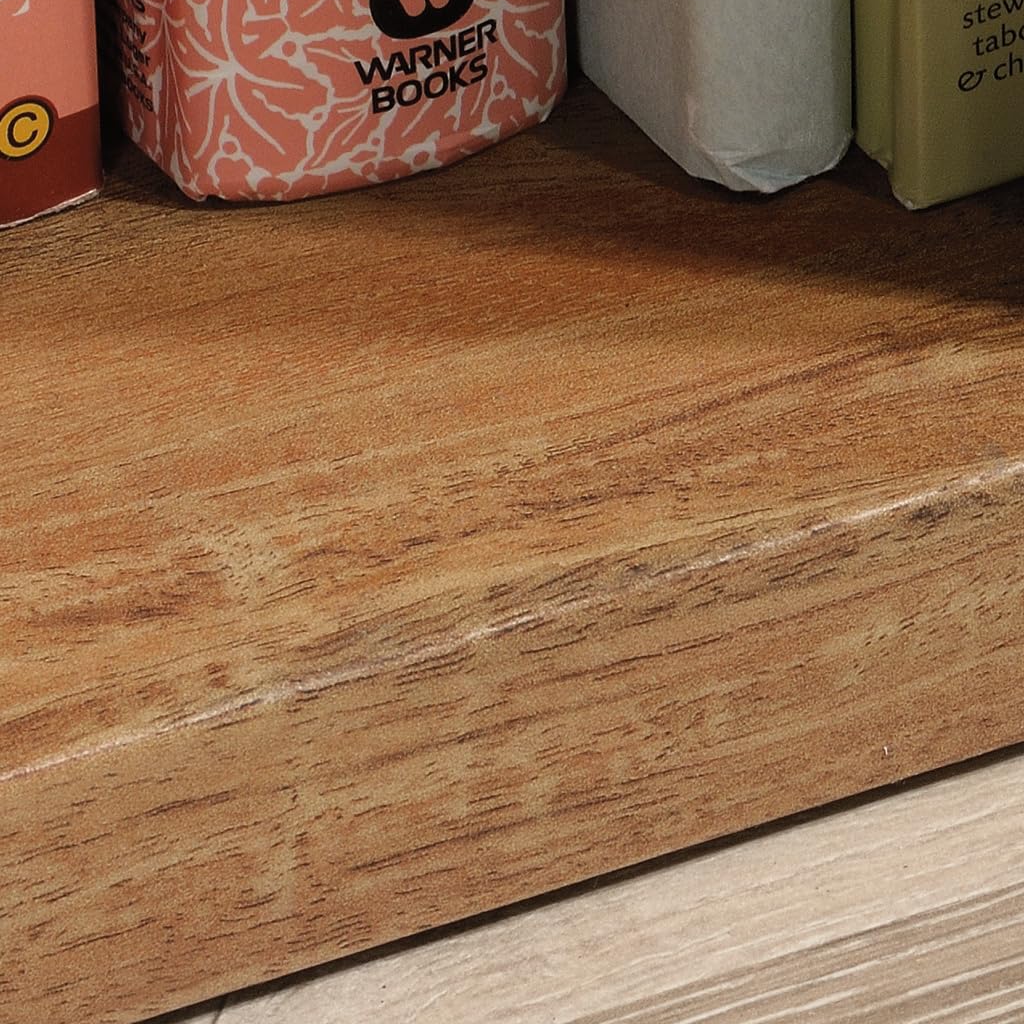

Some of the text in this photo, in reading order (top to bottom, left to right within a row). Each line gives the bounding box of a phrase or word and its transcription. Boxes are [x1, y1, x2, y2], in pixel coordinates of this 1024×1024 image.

[354, 19, 499, 85] WARNER
[958, 69, 987, 92] &
[372, 53, 489, 114] BOOKS
